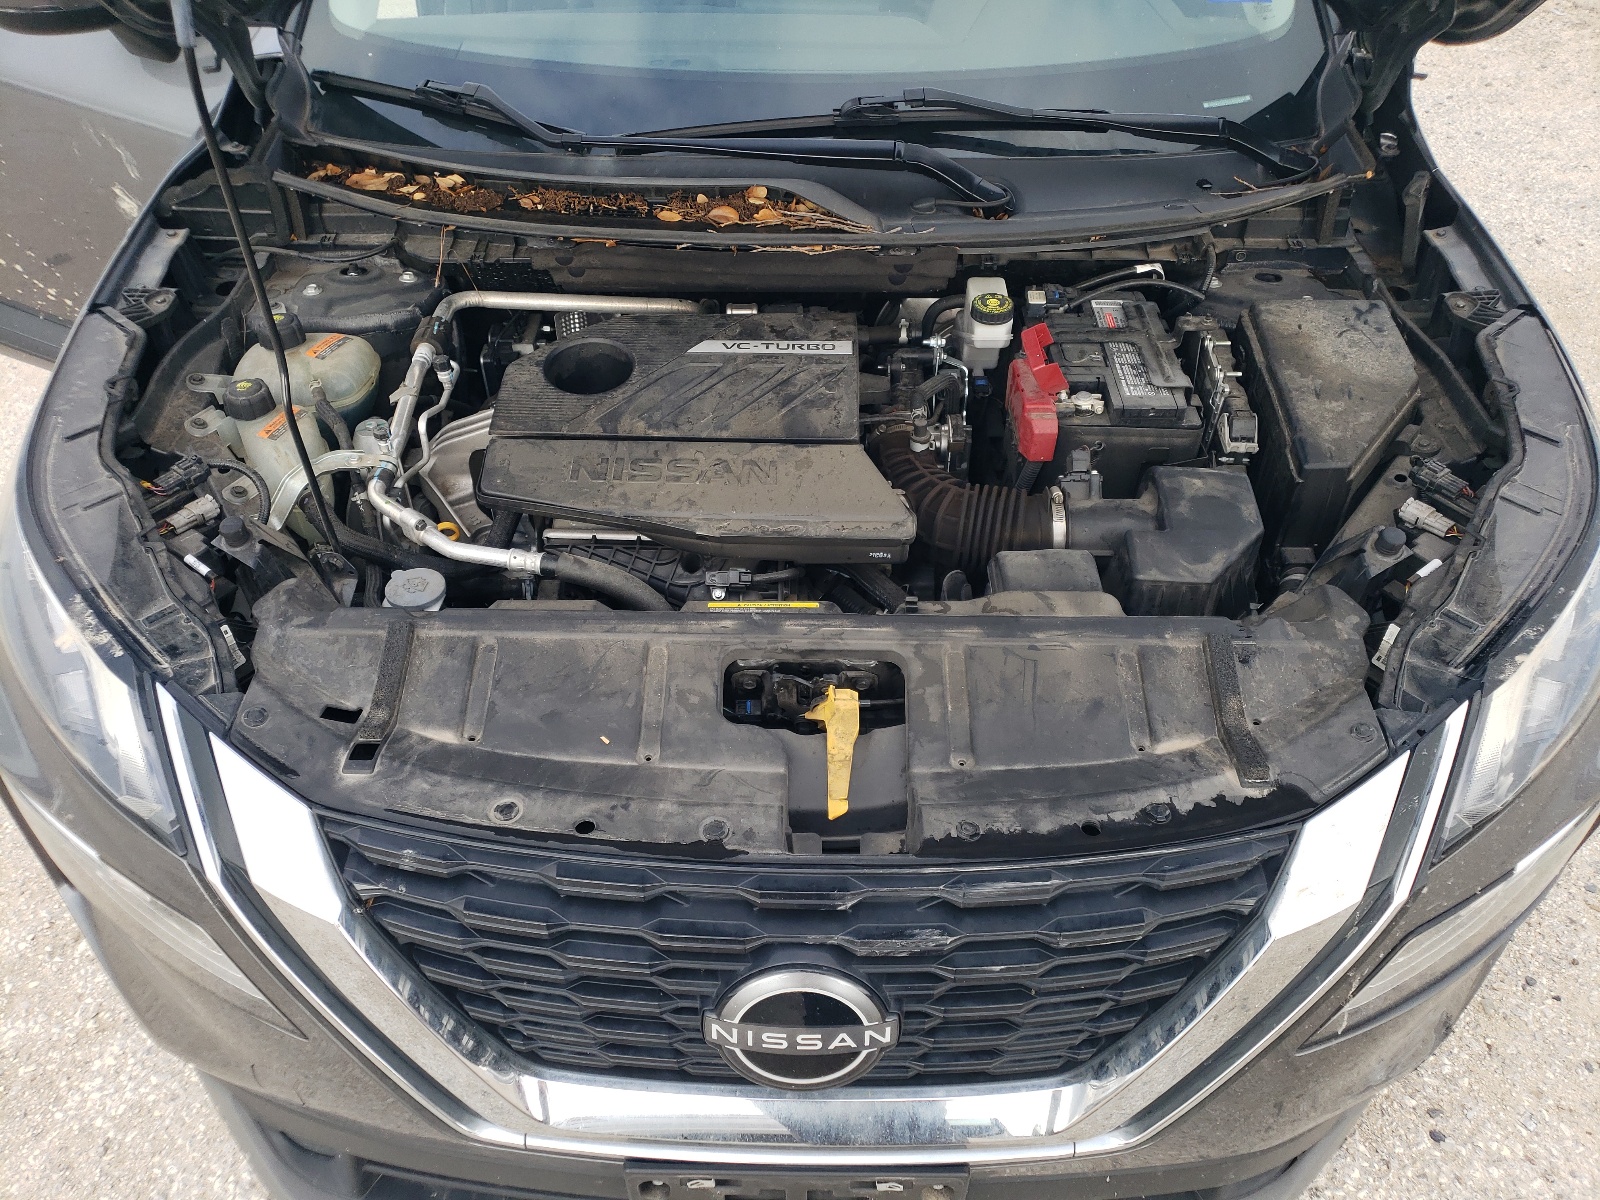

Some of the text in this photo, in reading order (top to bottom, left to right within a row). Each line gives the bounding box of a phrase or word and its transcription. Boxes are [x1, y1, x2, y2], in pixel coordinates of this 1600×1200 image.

[722, 342, 836, 351] VC-TURBO
[569, 458, 778, 485] NISSAN
[711, 1023, 891, 1050] NISSAN
